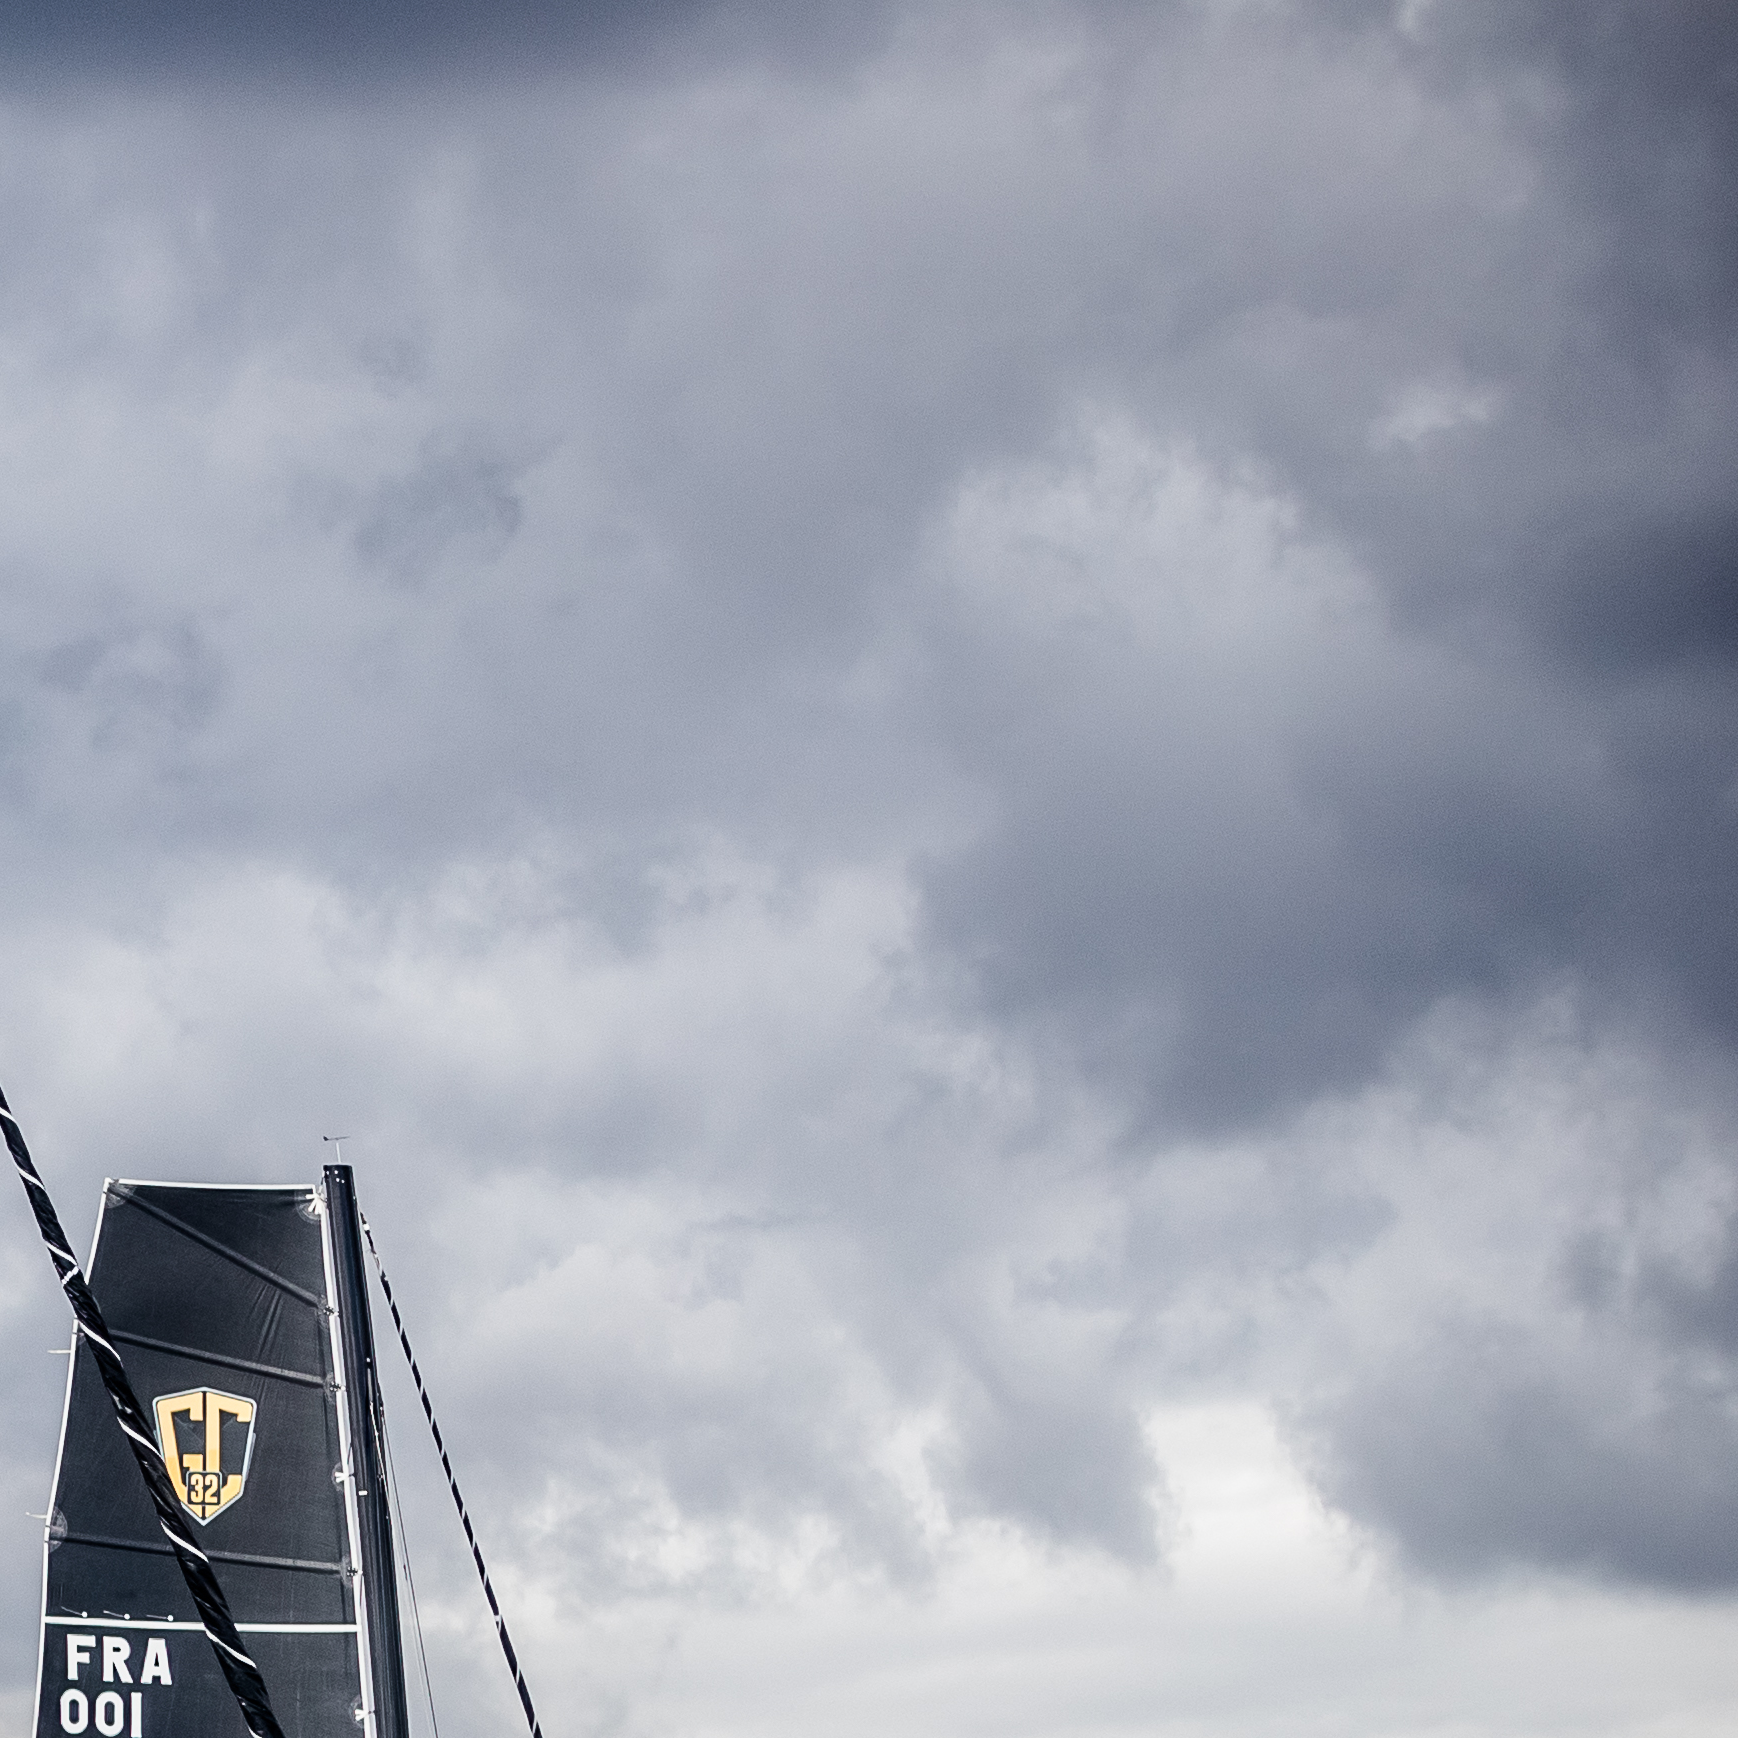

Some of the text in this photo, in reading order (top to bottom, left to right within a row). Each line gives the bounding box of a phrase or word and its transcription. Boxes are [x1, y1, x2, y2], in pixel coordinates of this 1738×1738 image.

[188, 1473, 219, 1504] 32
[65, 1633, 173, 1686] FRA
[59, 1688, 143, 1738] 001
